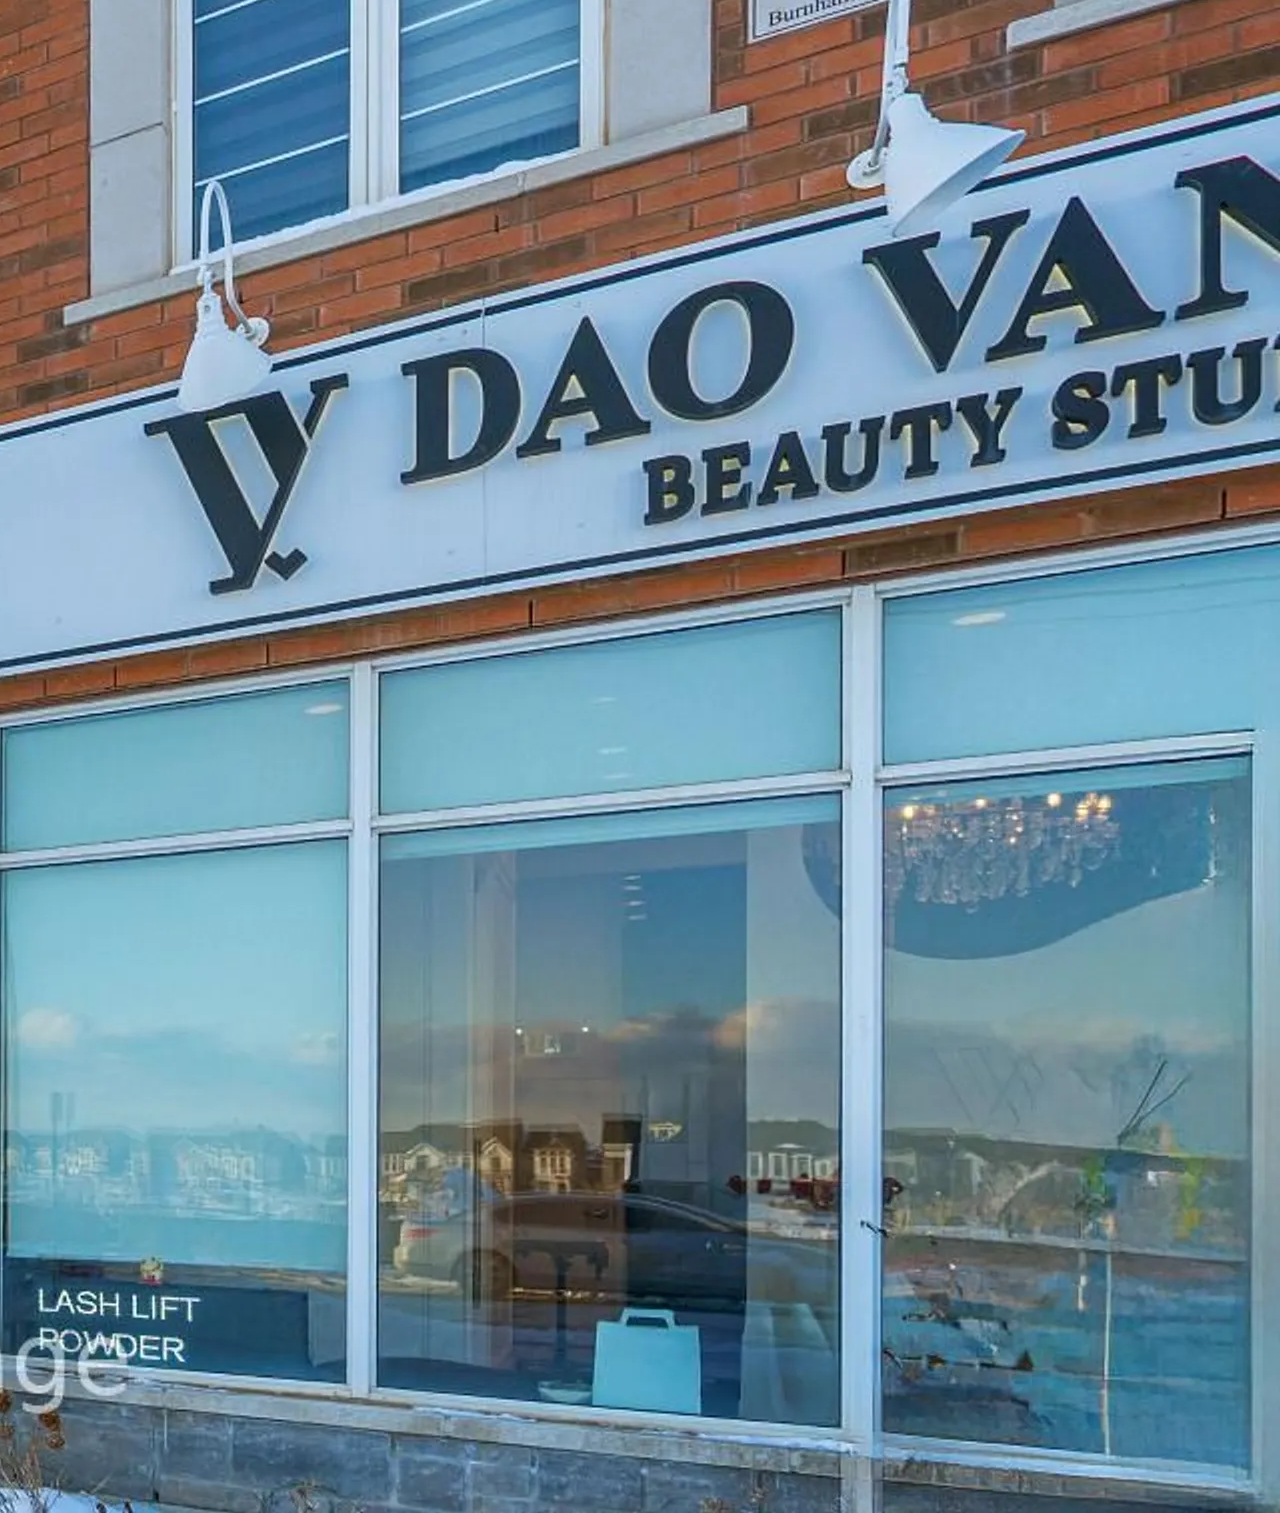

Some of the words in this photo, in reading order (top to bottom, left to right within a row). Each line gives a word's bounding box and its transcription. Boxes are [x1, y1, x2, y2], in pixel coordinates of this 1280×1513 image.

[400, 280, 795, 485] DAO
[643, 387, 1023, 526] BEAUTY
[1052, 334, 1280, 450] STU
[38, 1287, 120, 1318] LASH
[132, 1294, 201, 1322] LIFT
[39, 1326, 186, 1363] POWDER
